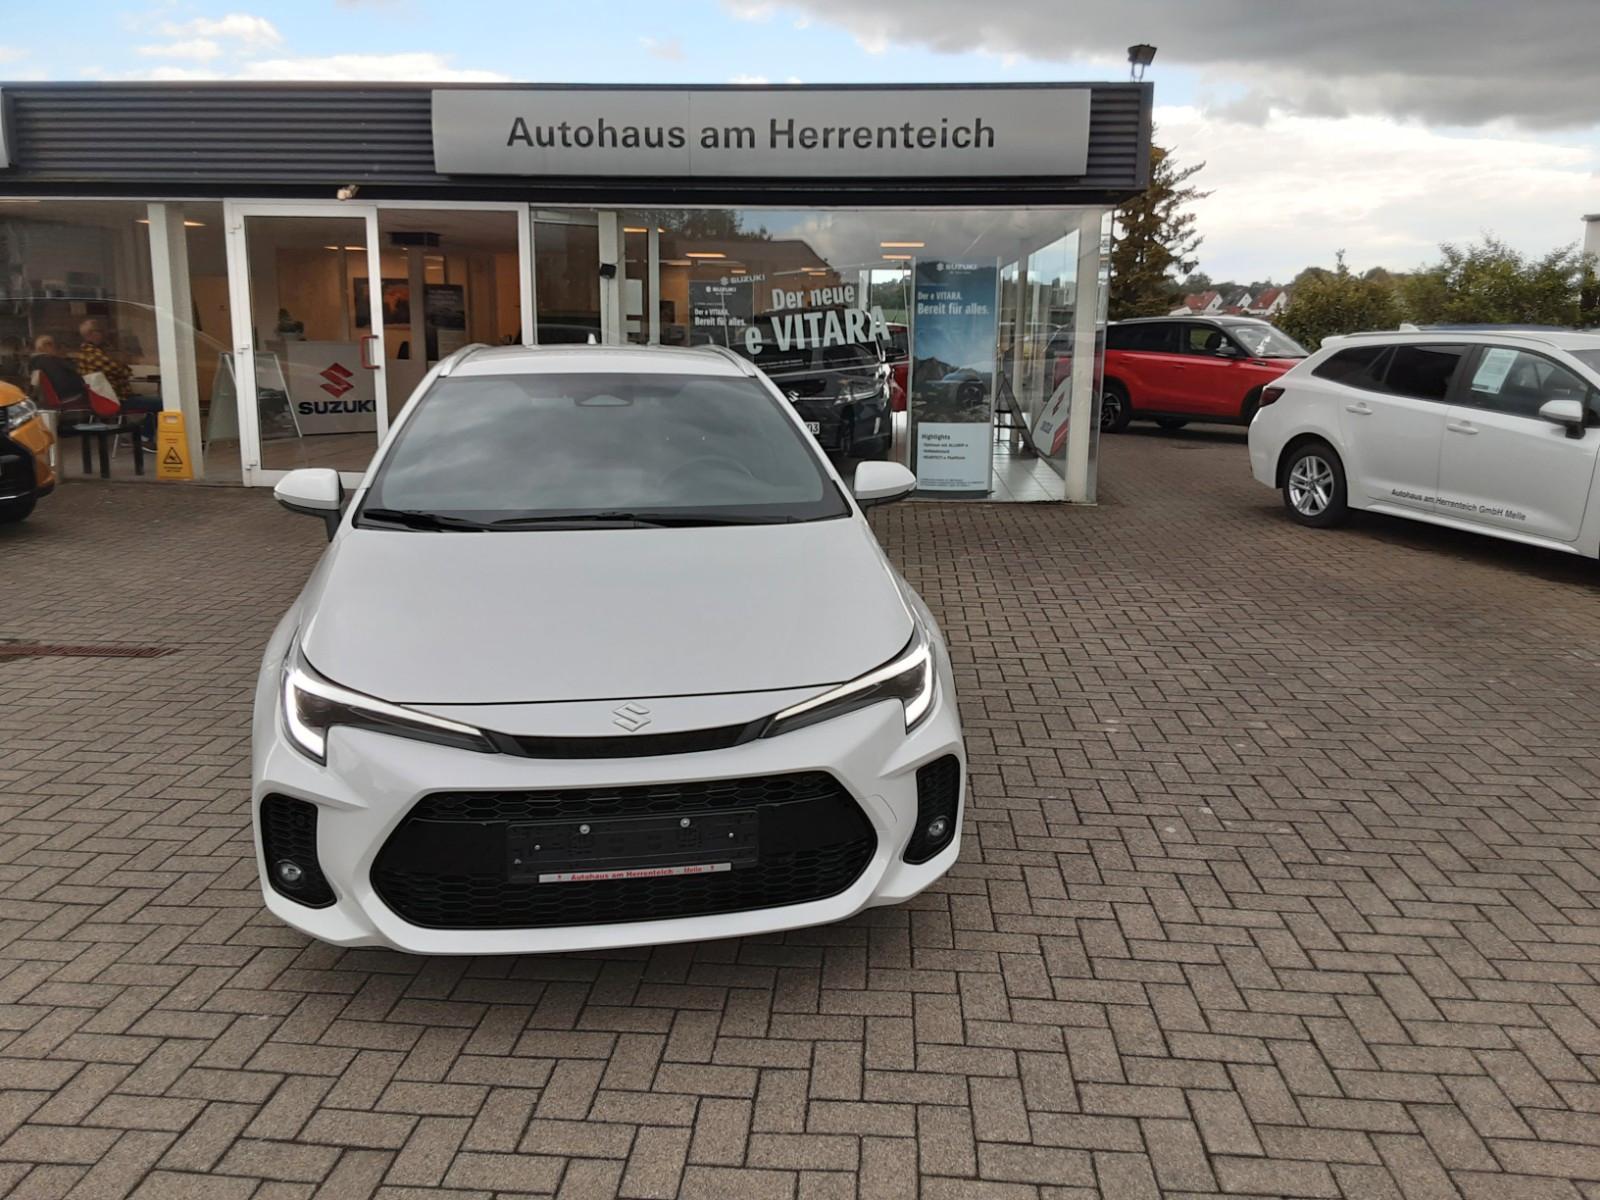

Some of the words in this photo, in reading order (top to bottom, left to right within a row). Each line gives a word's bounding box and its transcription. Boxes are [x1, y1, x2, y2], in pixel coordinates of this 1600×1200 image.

[507, 116, 686, 149] Autohaus
[700, 124, 756, 149] am
[769, 117, 995, 149] Herrenteich
[771, 288, 804, 311] Der
[810, 284, 855, 307] neue
[917, 291, 929, 300] Der
[694, 308, 704, 316] Der
[917, 302, 946, 315] Bereit
[948, 302, 962, 315] für
[694, 317, 715, 327] Bereit
[744, 326, 763, 355] e
[770, 305, 891, 352] VITARA
[298, 399, 377, 415] SUZUKI
[1391, 488, 1422, 501] Autohaus
[1424, 495, 1435, 503] am
[1436, 497, 1477, 512] Herrenteich
[1478, 505, 1504, 517] GmbH
[1505, 509, 1527, 521] Melle
[571, 872, 609, 881] Autohaus
[626, 867, 674, 878] Herrenteich
